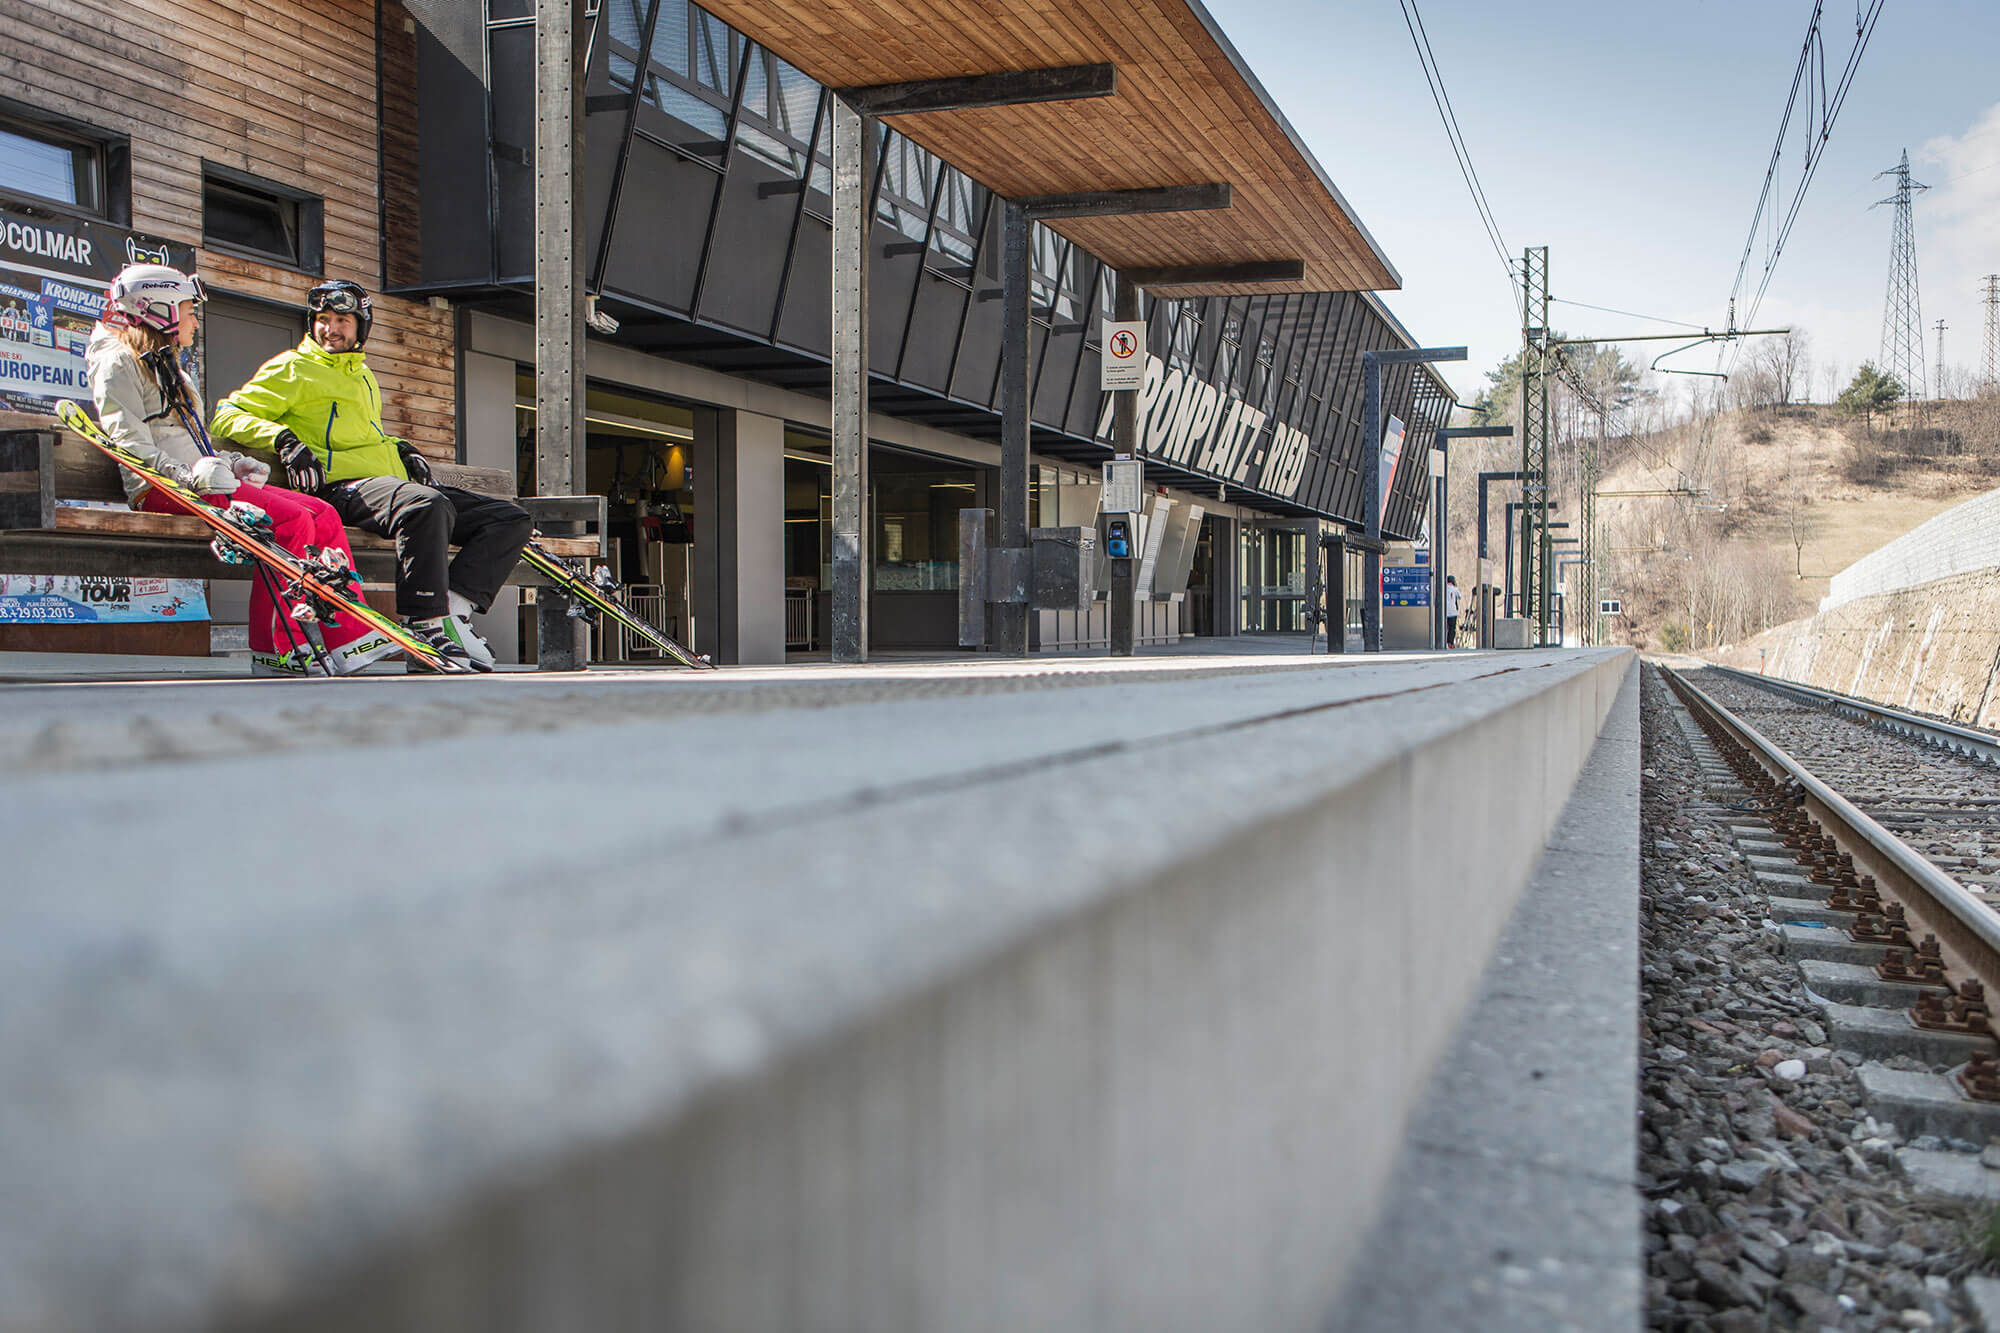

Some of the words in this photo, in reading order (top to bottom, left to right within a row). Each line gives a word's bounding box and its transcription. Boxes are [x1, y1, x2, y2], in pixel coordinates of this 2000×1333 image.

[7, 222, 92, 266] COLMAR
[0, 285, 41, 302] GIAPURA
[45, 282, 109, 311] KRONPLATZ
[0, 359, 73, 386] UROPEAN
[79, 370, 88, 388] C
[1258, 421, 1310, 498] RIED
[80, 584, 131, 602] TOUR
[0, 607, 75, 618] 8.+29.03.2015
[343, 637, 393, 659] HEA
